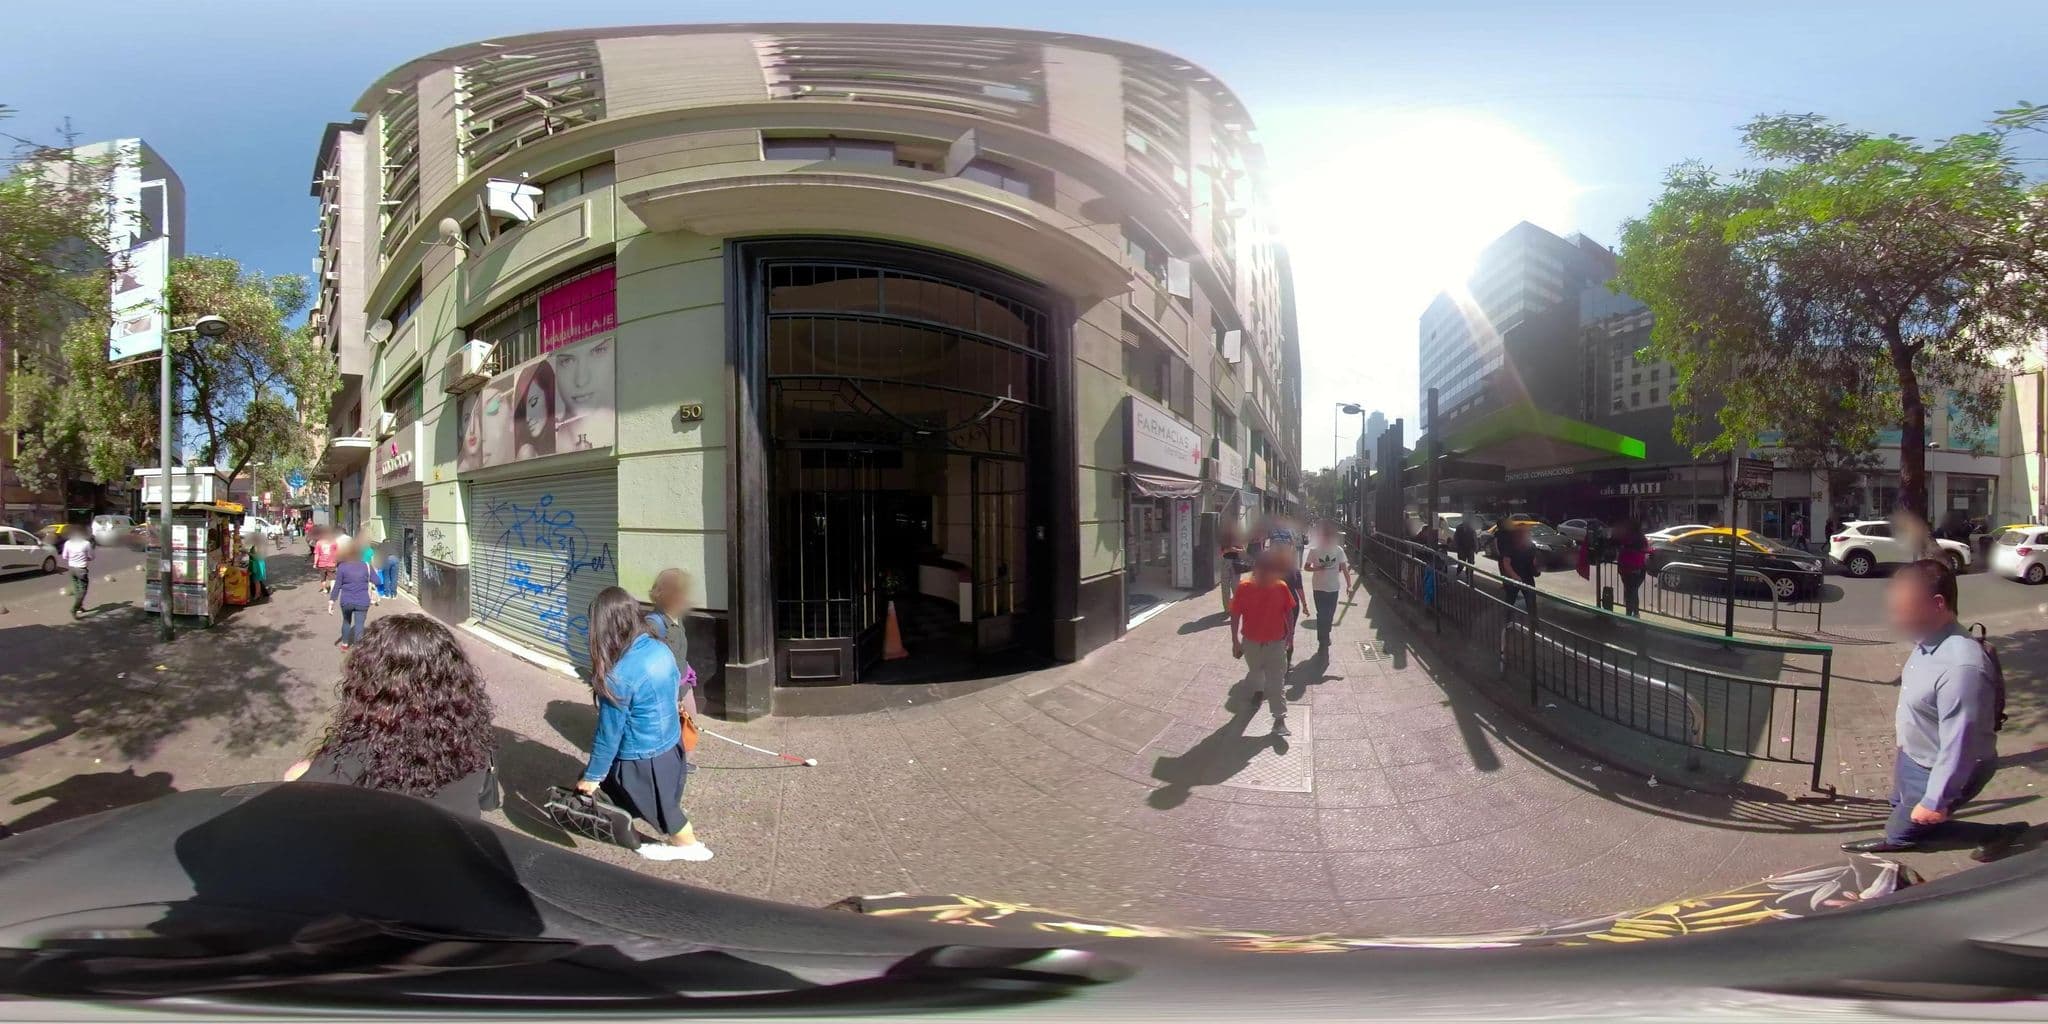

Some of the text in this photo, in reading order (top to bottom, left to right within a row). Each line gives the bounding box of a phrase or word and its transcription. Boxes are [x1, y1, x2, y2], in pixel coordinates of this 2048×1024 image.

[544, 313, 614, 345] MAQUILLAJE
[682, 406, 701, 418] 50
[1136, 412, 1190, 449] FARMACIAS
[1620, 482, 1661, 495] HAITI
